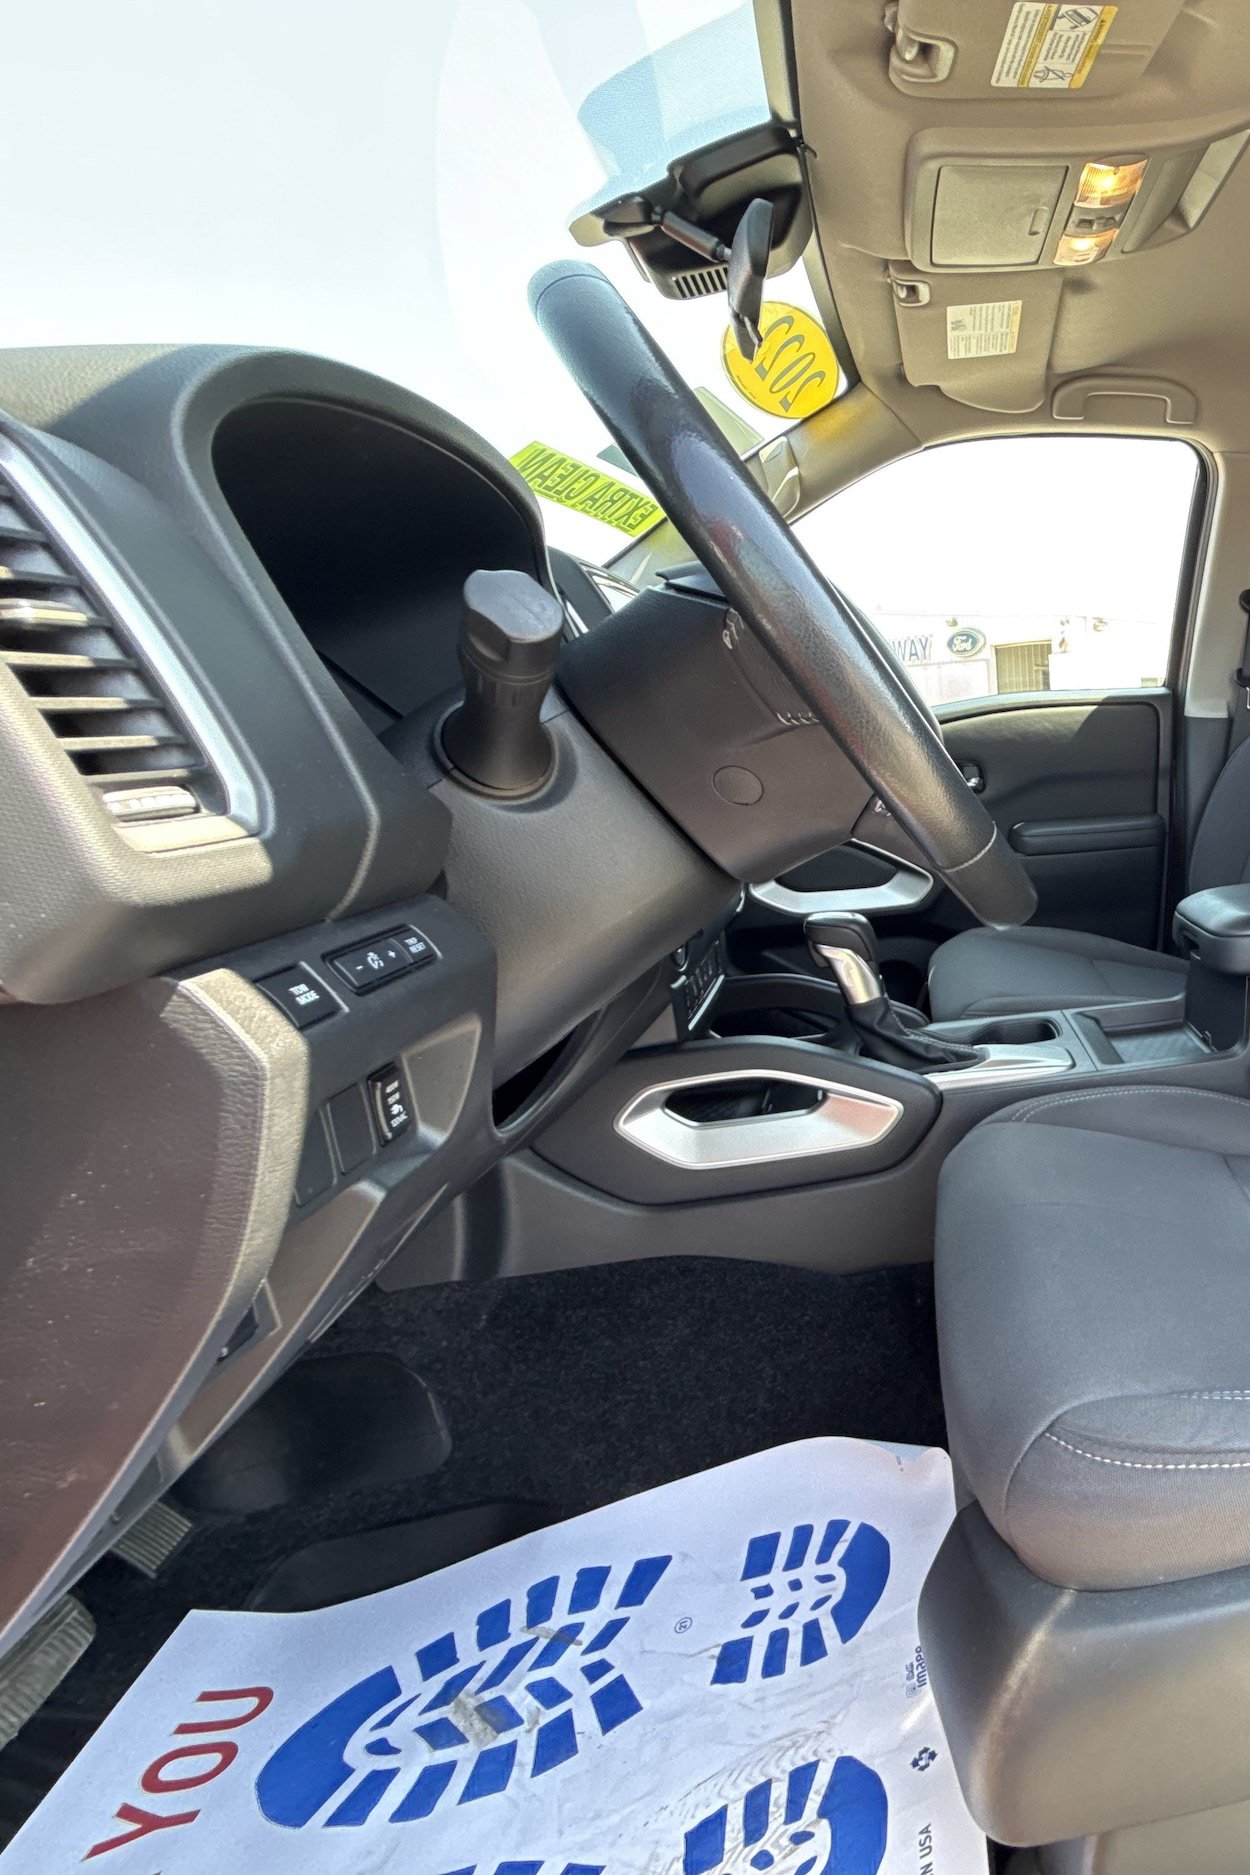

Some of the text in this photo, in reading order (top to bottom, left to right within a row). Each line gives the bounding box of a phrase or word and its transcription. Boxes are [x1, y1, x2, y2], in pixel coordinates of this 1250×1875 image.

[952, 636, 973, 652] Ford
[80, 1686, 274, 1862] YOU
[917, 1822, 932, 1859] USA
